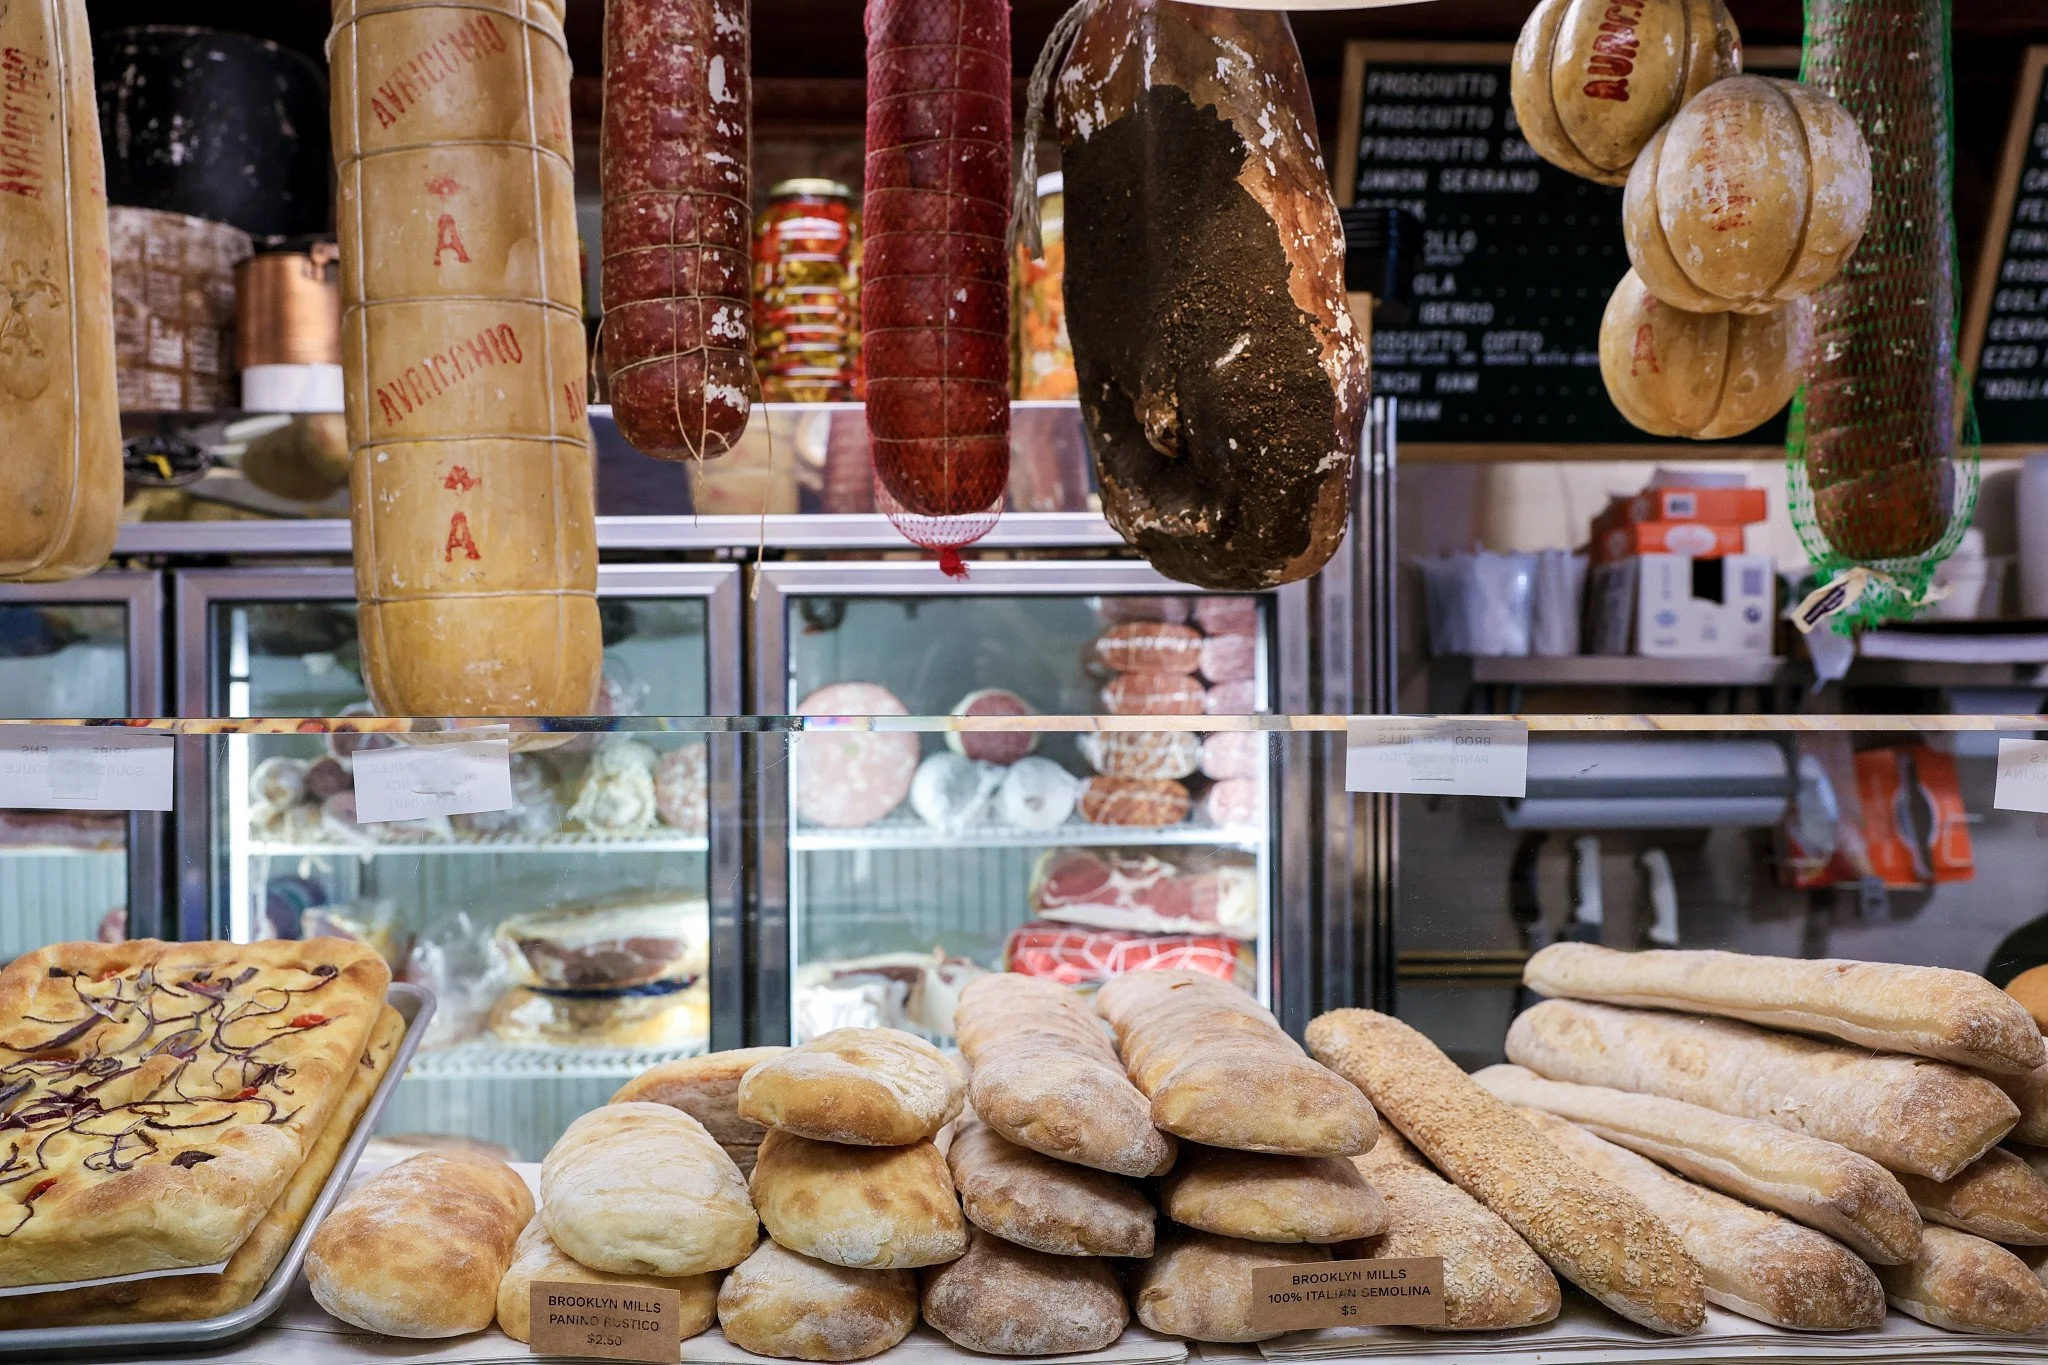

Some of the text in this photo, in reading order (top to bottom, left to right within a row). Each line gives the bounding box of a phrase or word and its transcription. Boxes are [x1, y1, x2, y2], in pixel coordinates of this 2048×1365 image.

[1367, 72, 1497, 98] PROSCIUTTO
[1364, 104, 1493, 130] PROSCIUTTO
[1360, 136, 1489, 161] PROSCIUTTO
[1439, 168, 1540, 192] SERRANO
[1292, 1269, 1407, 1285] BROOKLYN MILLS
[1268, 1285, 1431, 1304] 100% ITALIAN SEMOLINA
[548, 1295, 661, 1313] BROOKLYN MILLS
[1341, 1305, 1357, 1316] $5
[549, 1314, 659, 1332] PANINO RUSTICO
[587, 1333, 622, 1346] $2.50
